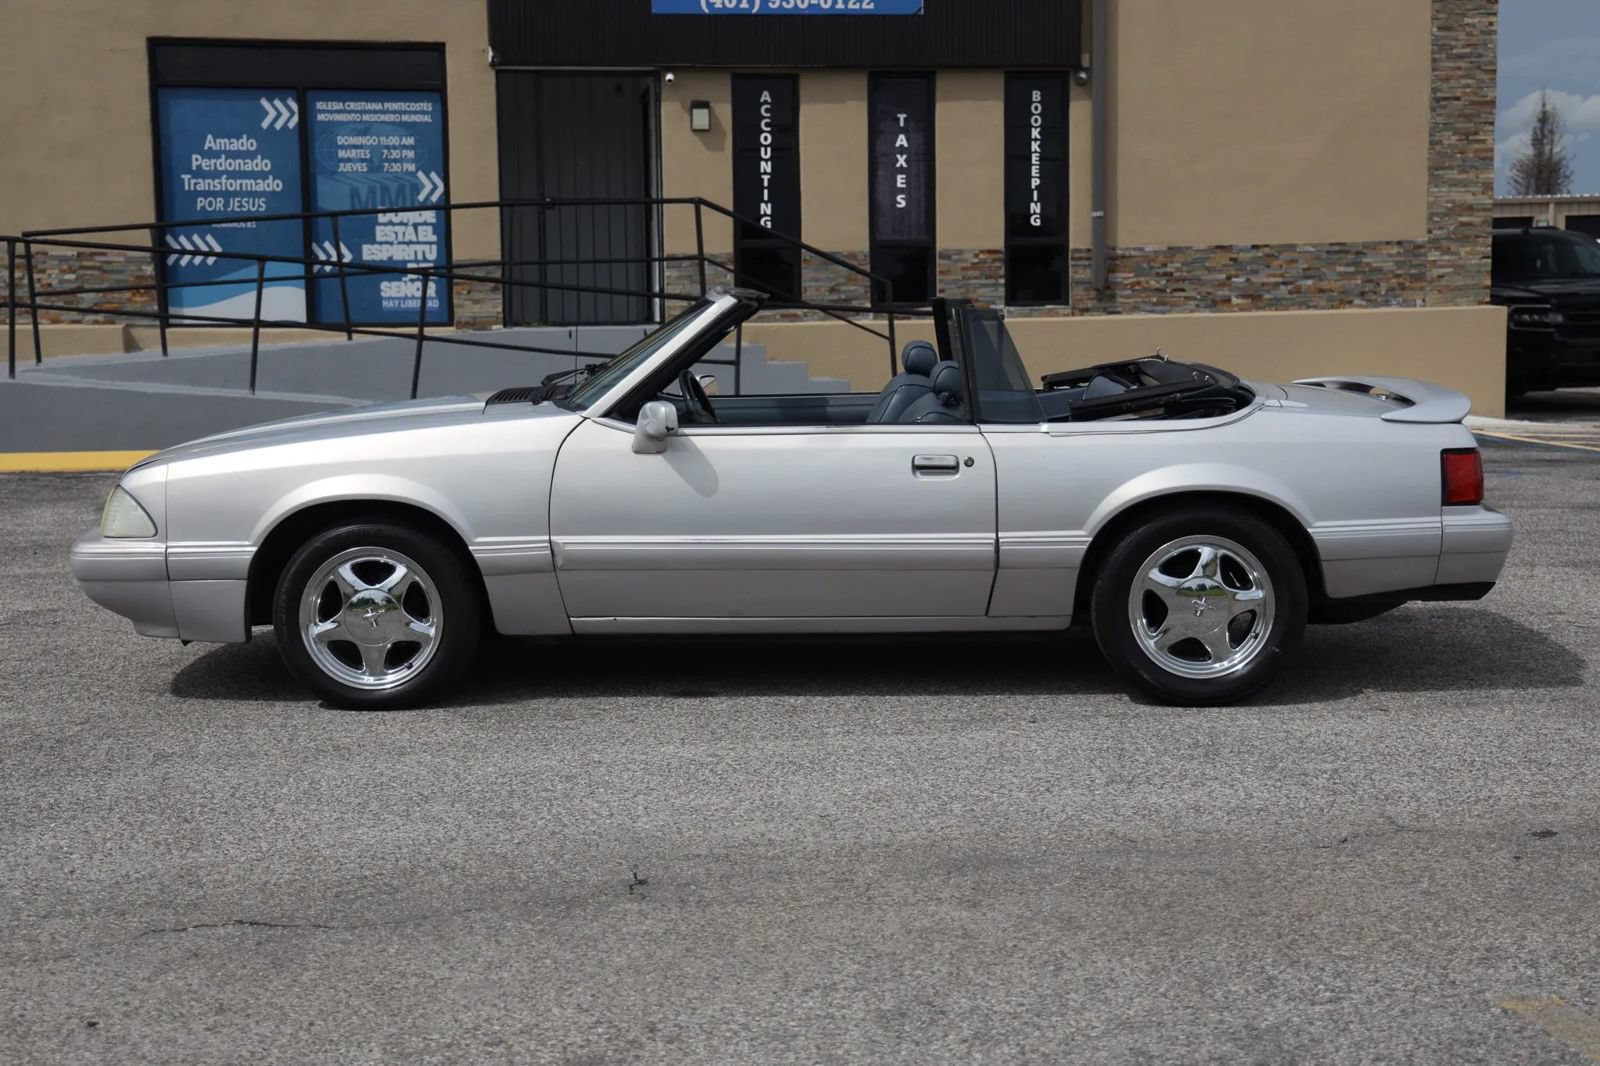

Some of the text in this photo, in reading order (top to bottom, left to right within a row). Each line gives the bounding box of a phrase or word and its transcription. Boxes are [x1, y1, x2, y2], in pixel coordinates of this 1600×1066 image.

[316, 101, 433, 111] IGLESIA CRISTIANA PENTECOSTÉS
[204, 134, 257, 151] Amado
[337, 136, 378, 145] DOMINGO
[401, 136, 415, 145] AM
[191, 154, 271, 171] Perdonado
[337, 149, 415, 159] MARTES 7:30 PM
[760, 90, 772, 228] ACCOUNTING
[895, 114, 908, 208] TAXES
[1030, 90, 1042, 227] BOOKKEEPING
[338, 163, 416, 172] JUEVES 7:30 PM
[181, 174, 283, 192] Transformado
[196, 197, 267, 211] POR JESUS
